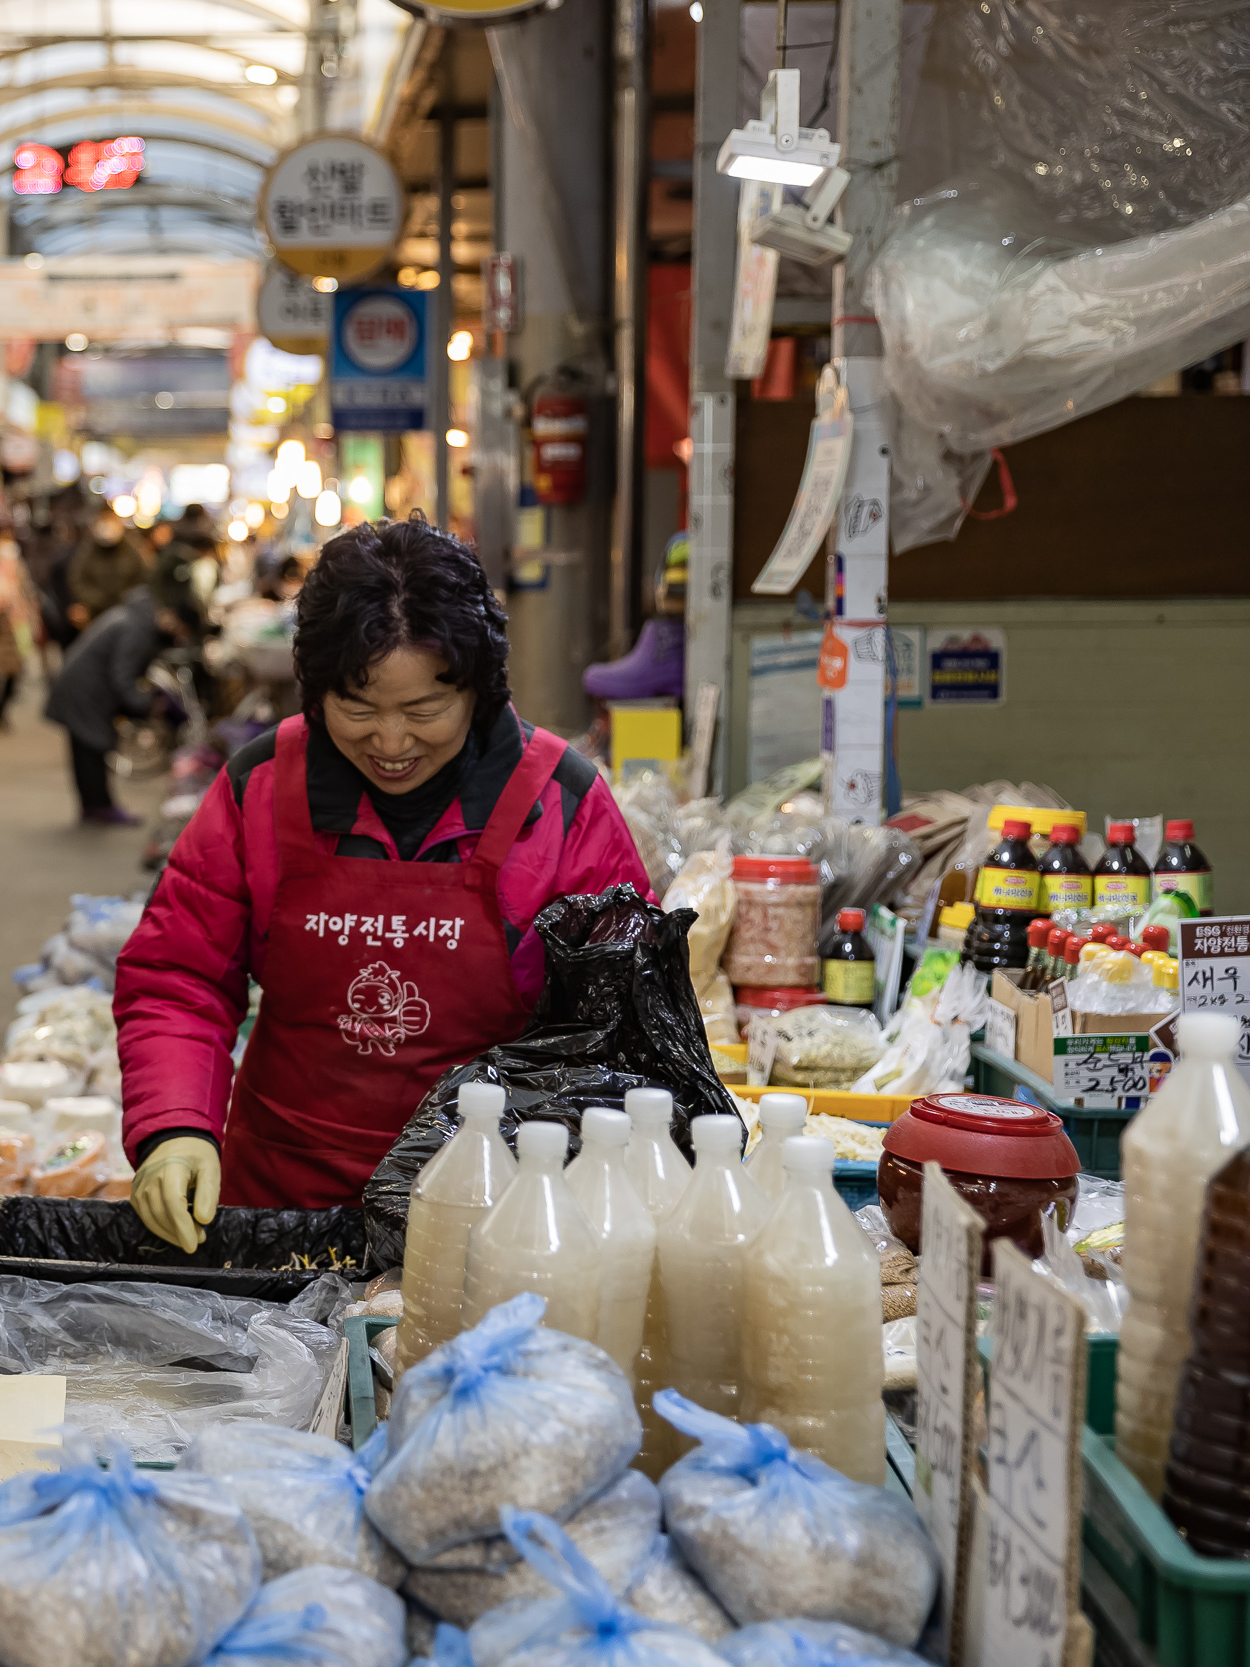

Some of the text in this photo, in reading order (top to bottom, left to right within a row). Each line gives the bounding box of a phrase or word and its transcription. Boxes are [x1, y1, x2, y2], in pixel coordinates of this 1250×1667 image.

[274, 197, 391, 237] 할인마트
[304, 912, 465, 950] 자양전통시장
[1196, 926, 1221, 937] ESG
[1187, 966, 1241, 992] 새우
